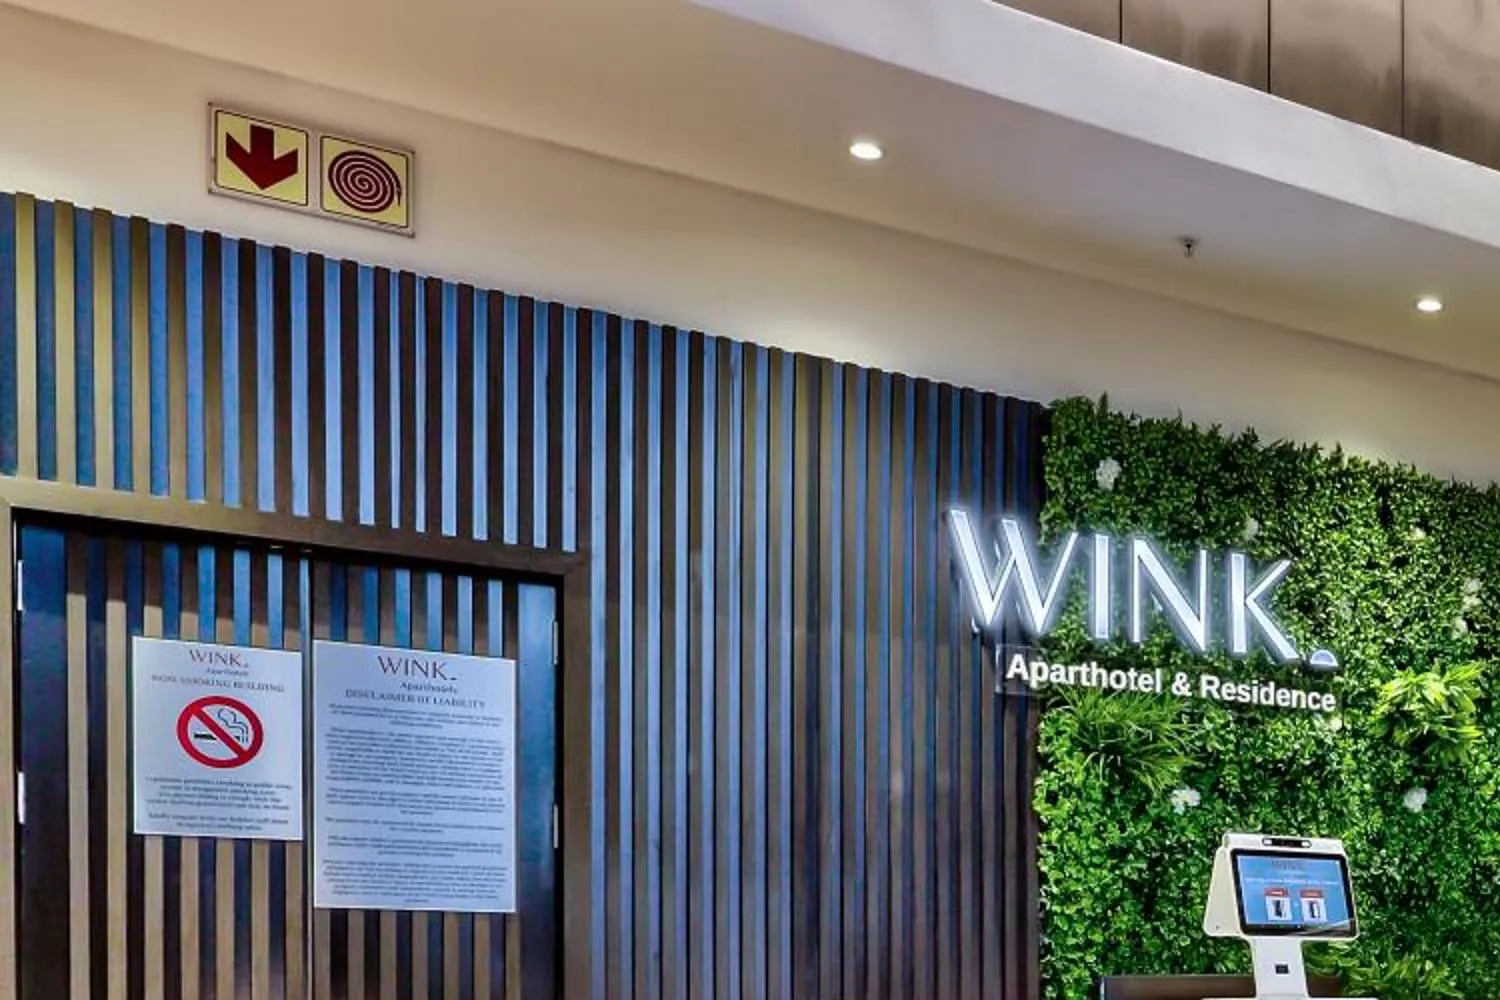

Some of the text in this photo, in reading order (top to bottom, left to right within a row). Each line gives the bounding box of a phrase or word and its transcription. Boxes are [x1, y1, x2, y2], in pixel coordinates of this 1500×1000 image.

[1005, 653, 1337, 711] Aparthotel & Residence
